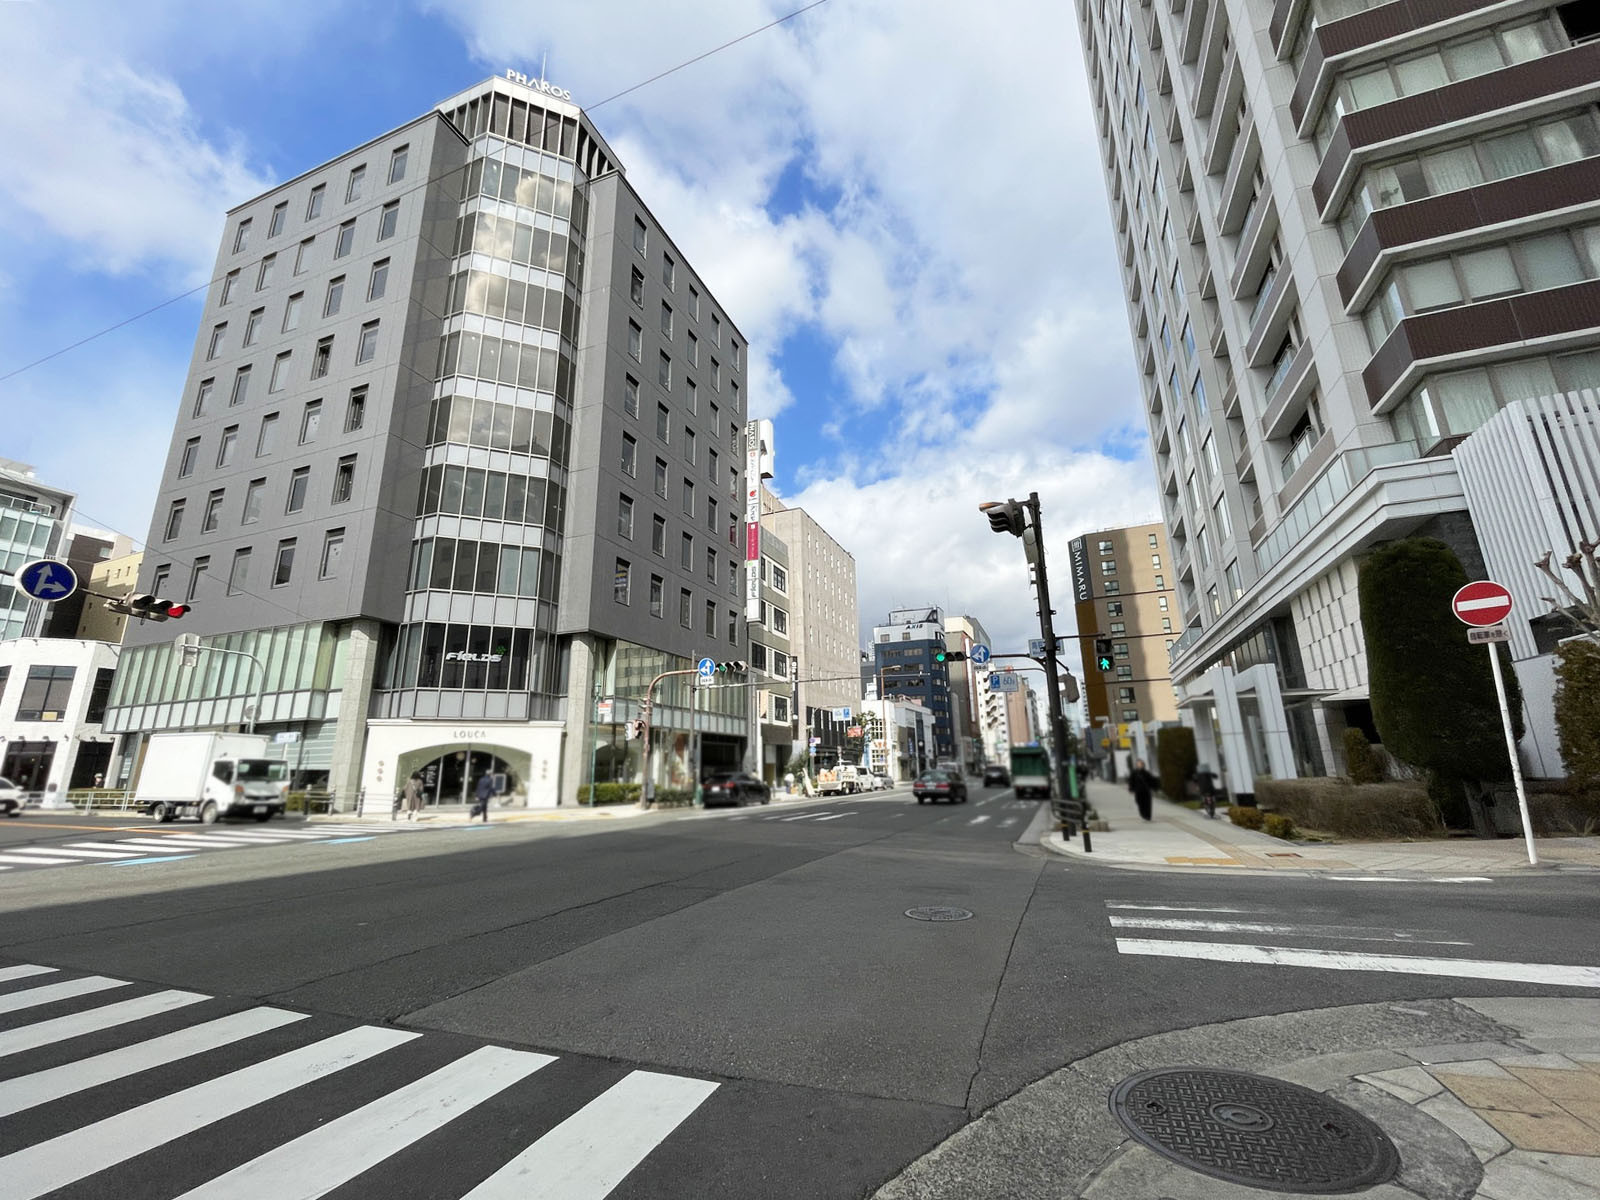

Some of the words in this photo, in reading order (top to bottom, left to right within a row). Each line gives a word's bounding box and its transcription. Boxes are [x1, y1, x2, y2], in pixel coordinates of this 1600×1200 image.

[506, 69, 571, 101] PHAROS
[1074, 551, 1087, 600] MIMARU
[453, 730, 486, 738] LOUCA
